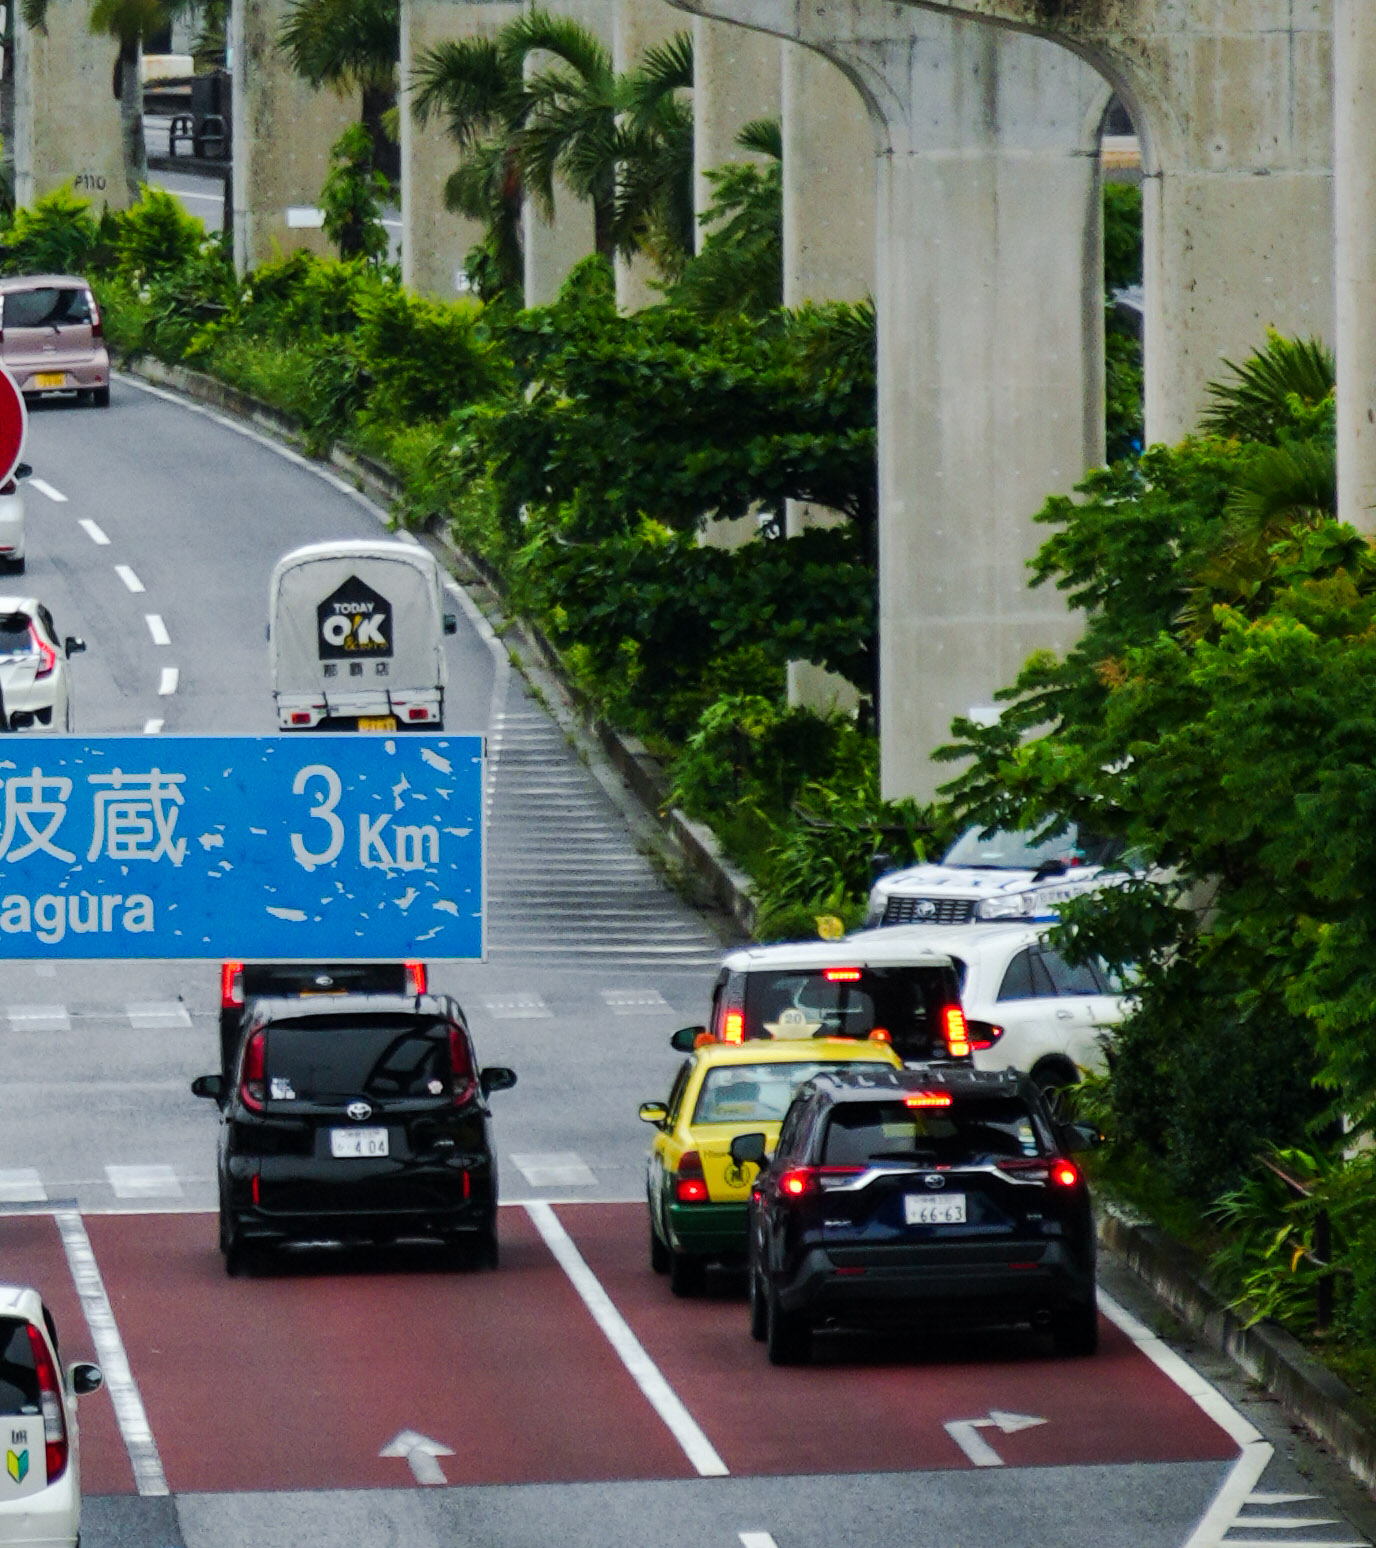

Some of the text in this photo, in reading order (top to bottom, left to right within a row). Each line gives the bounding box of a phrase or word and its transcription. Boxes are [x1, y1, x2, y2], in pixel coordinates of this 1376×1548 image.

[74, 174, 106, 191] P110
[333, 603, 375, 614] TODAY
[291, 764, 345, 868] 3
[359, 813, 441, 867] Km
[920, 1206, 963, 1222] 66-63
